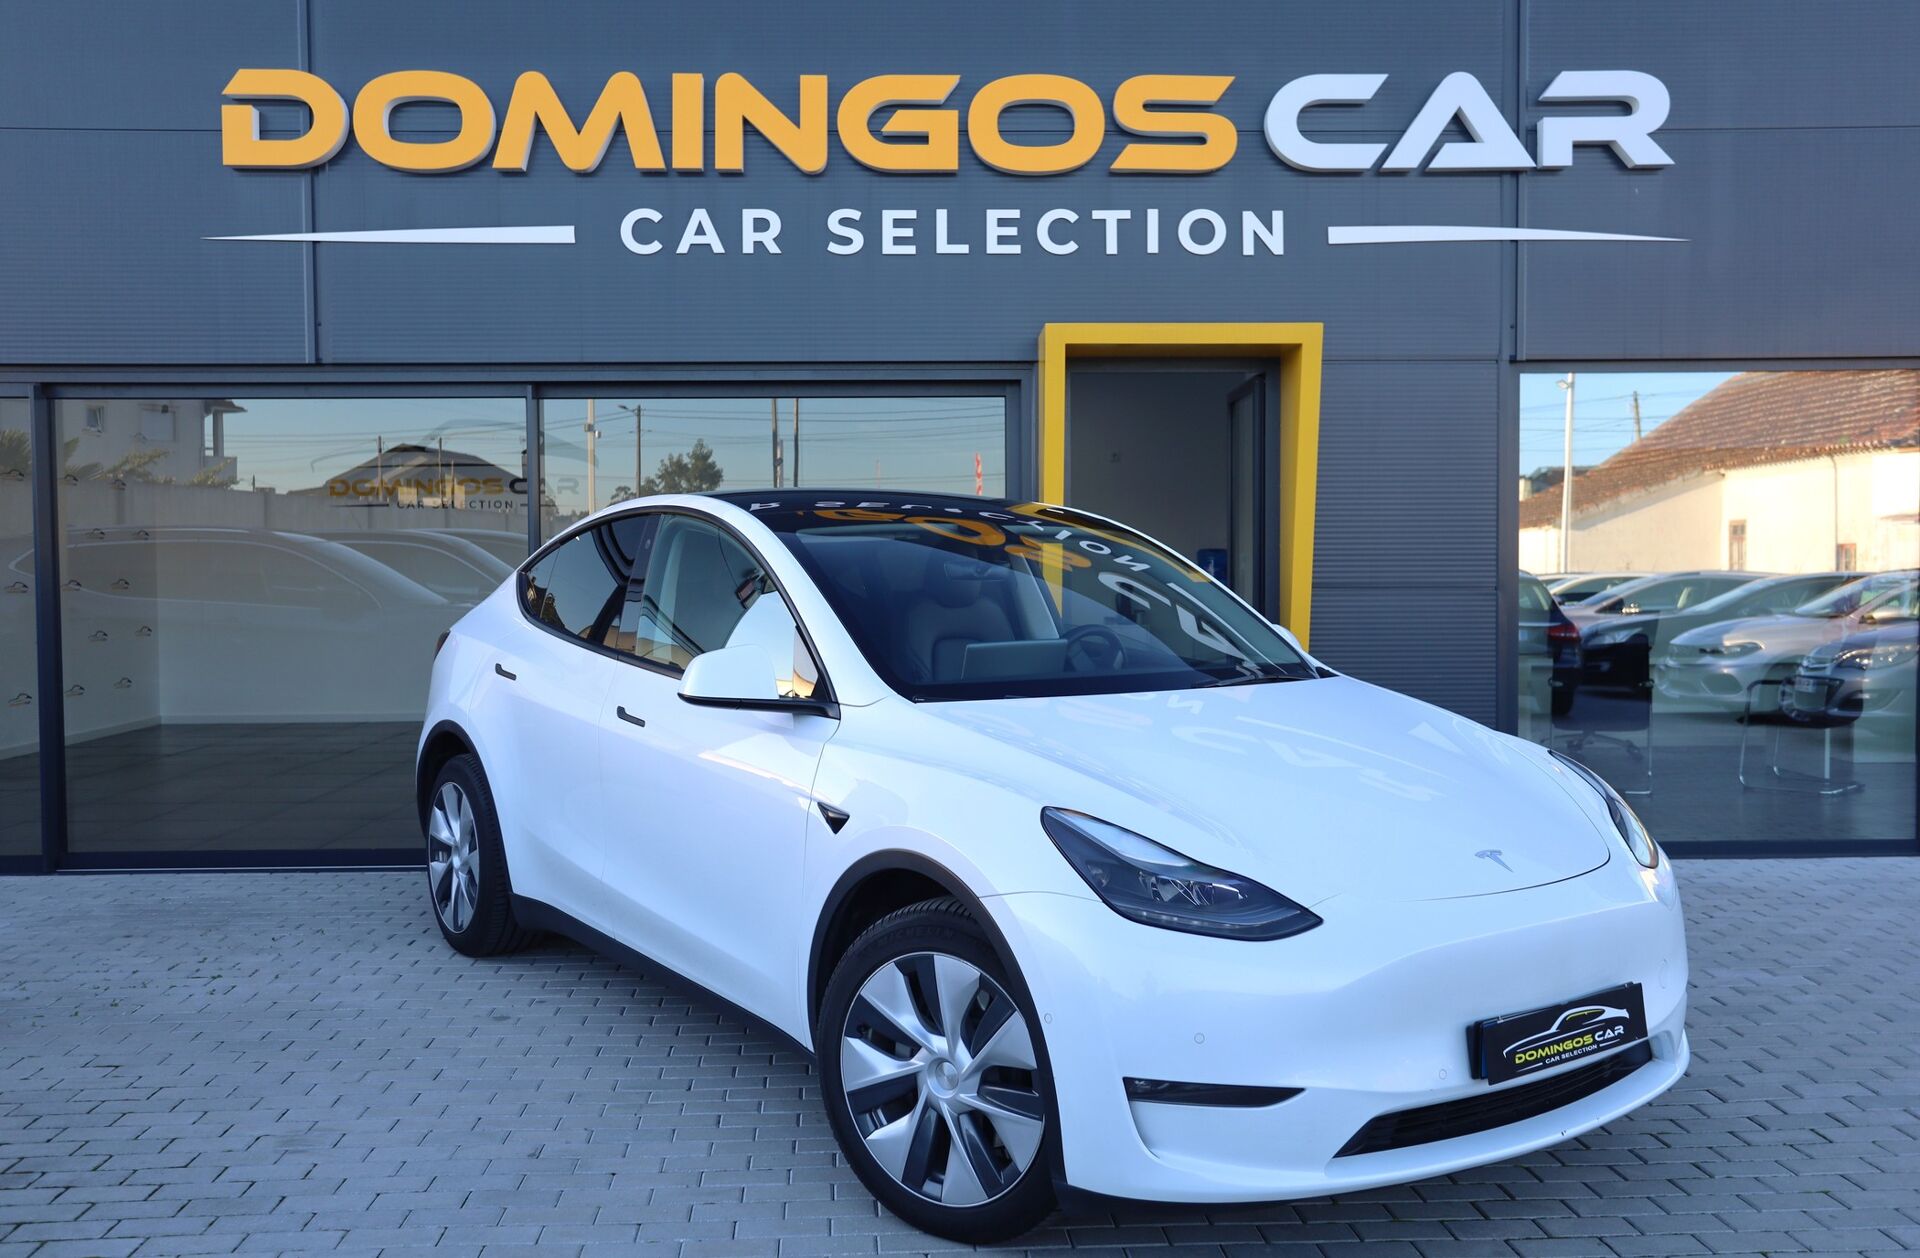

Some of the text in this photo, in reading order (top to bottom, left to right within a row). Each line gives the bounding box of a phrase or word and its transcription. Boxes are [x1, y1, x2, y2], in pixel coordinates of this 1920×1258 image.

[221, 68, 1676, 175] DOMINGOS CAR
[620, 207, 1286, 257] CAR SELECTION
[431, 499, 514, 510] SELCTION
[1515, 1025, 1625, 1064] DOMINGOS CAR
[1545, 1044, 1598, 1064] CAR SELECTION
